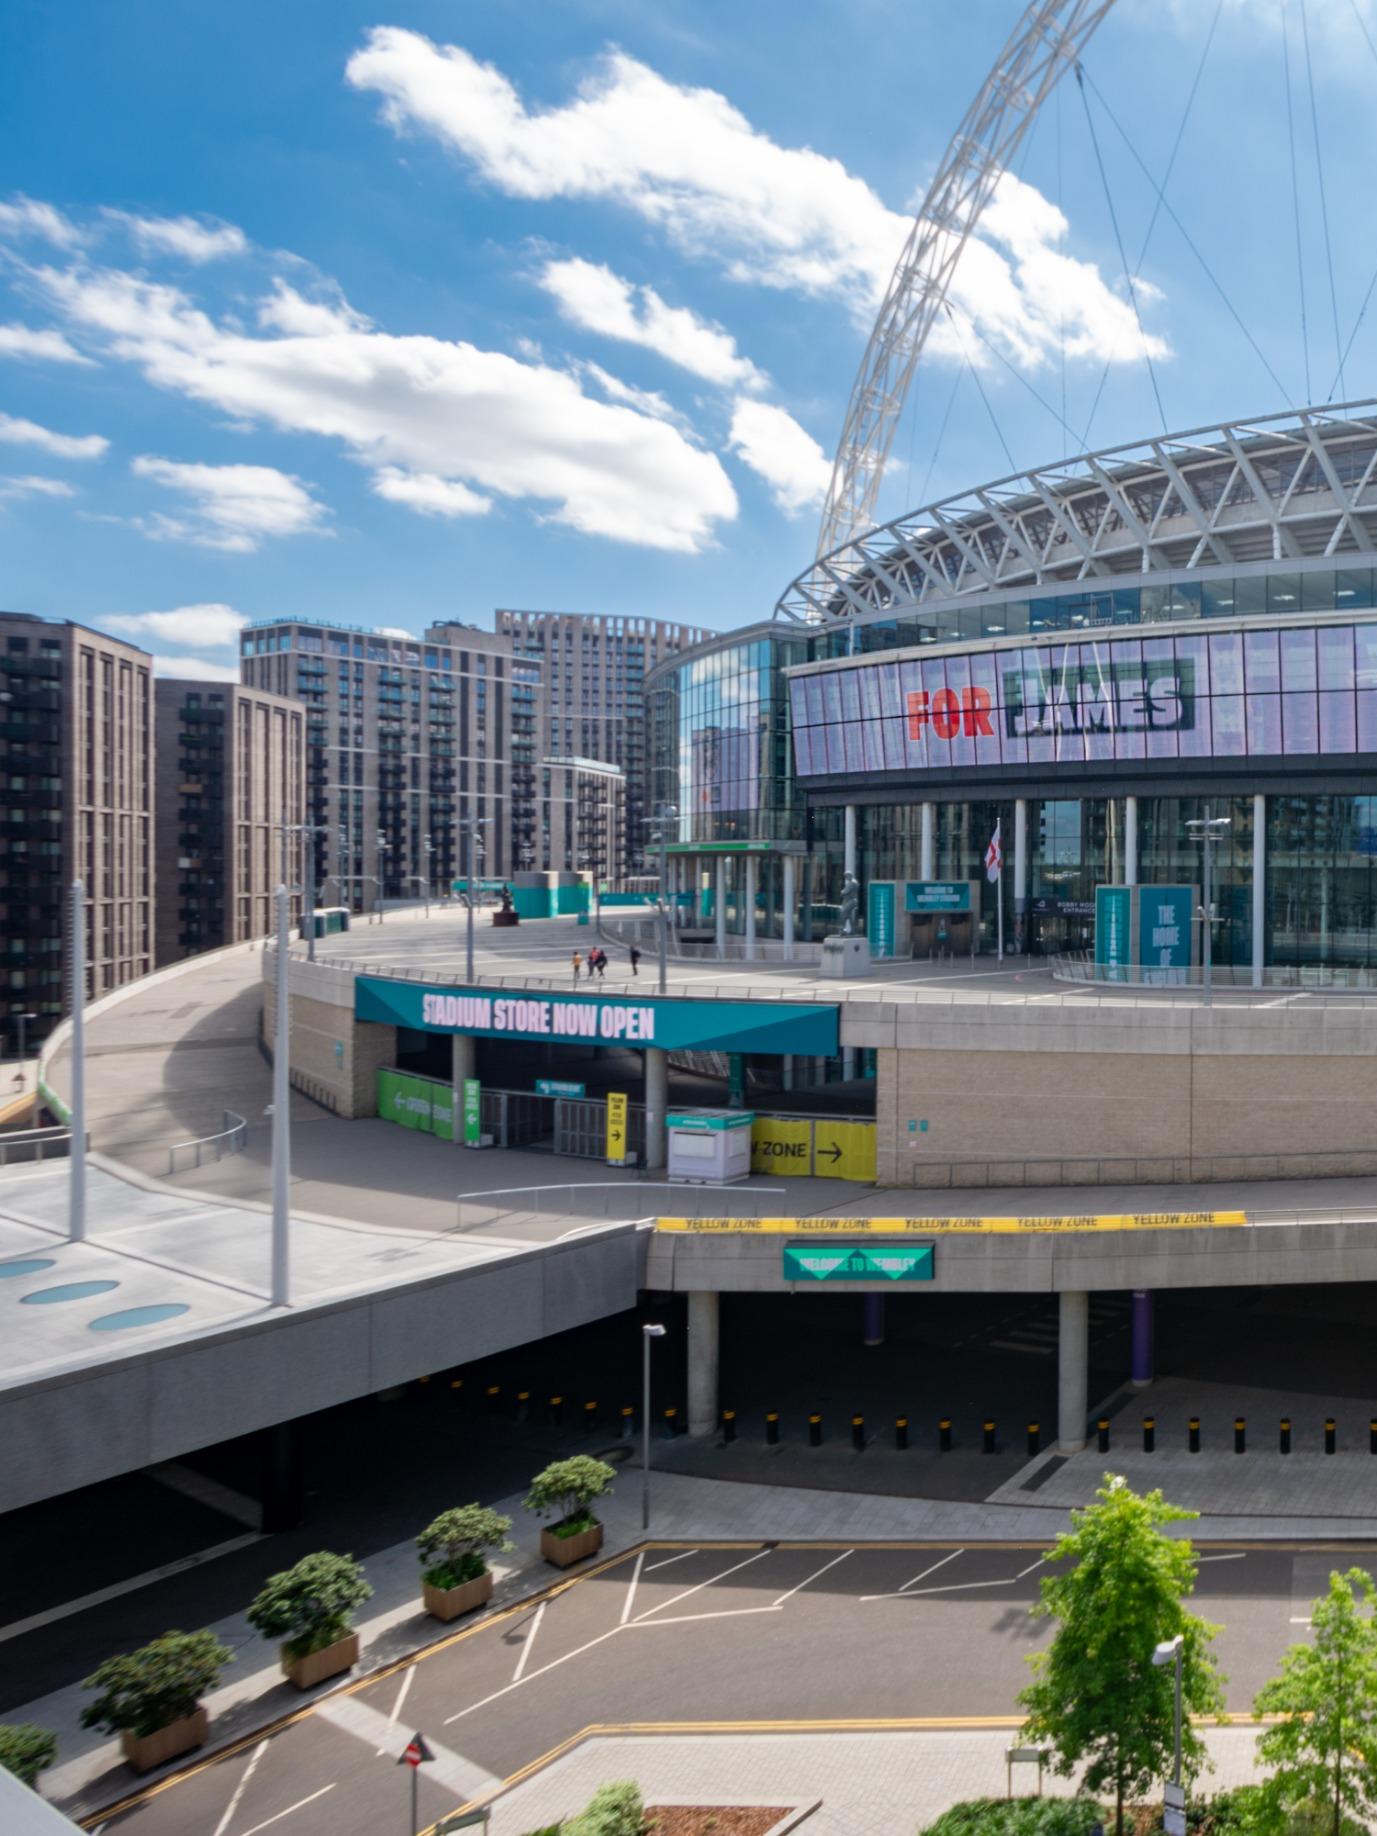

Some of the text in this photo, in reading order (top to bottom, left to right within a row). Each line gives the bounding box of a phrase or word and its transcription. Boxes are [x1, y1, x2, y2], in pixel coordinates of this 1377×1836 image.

[907, 676, 1183, 741] FOR JAMES
[1158, 905, 1175, 925] THE
[1152, 926, 1180, 947] HOME
[423, 994, 655, 1040] STADIUM STORE NOW OPEN
[763, 1142, 807, 1158] ZONE
[686, 1219, 731, 1230] YELLOW
[795, 1219, 872, 1230] YELLOW ZONE
[904, 1218, 949, 1229] YELLOW
[1017, 1217, 1063, 1228] YELLOW
[1133, 1215, 1180, 1226] YELLOW
[800, 1257, 849, 1271] WELCOME
